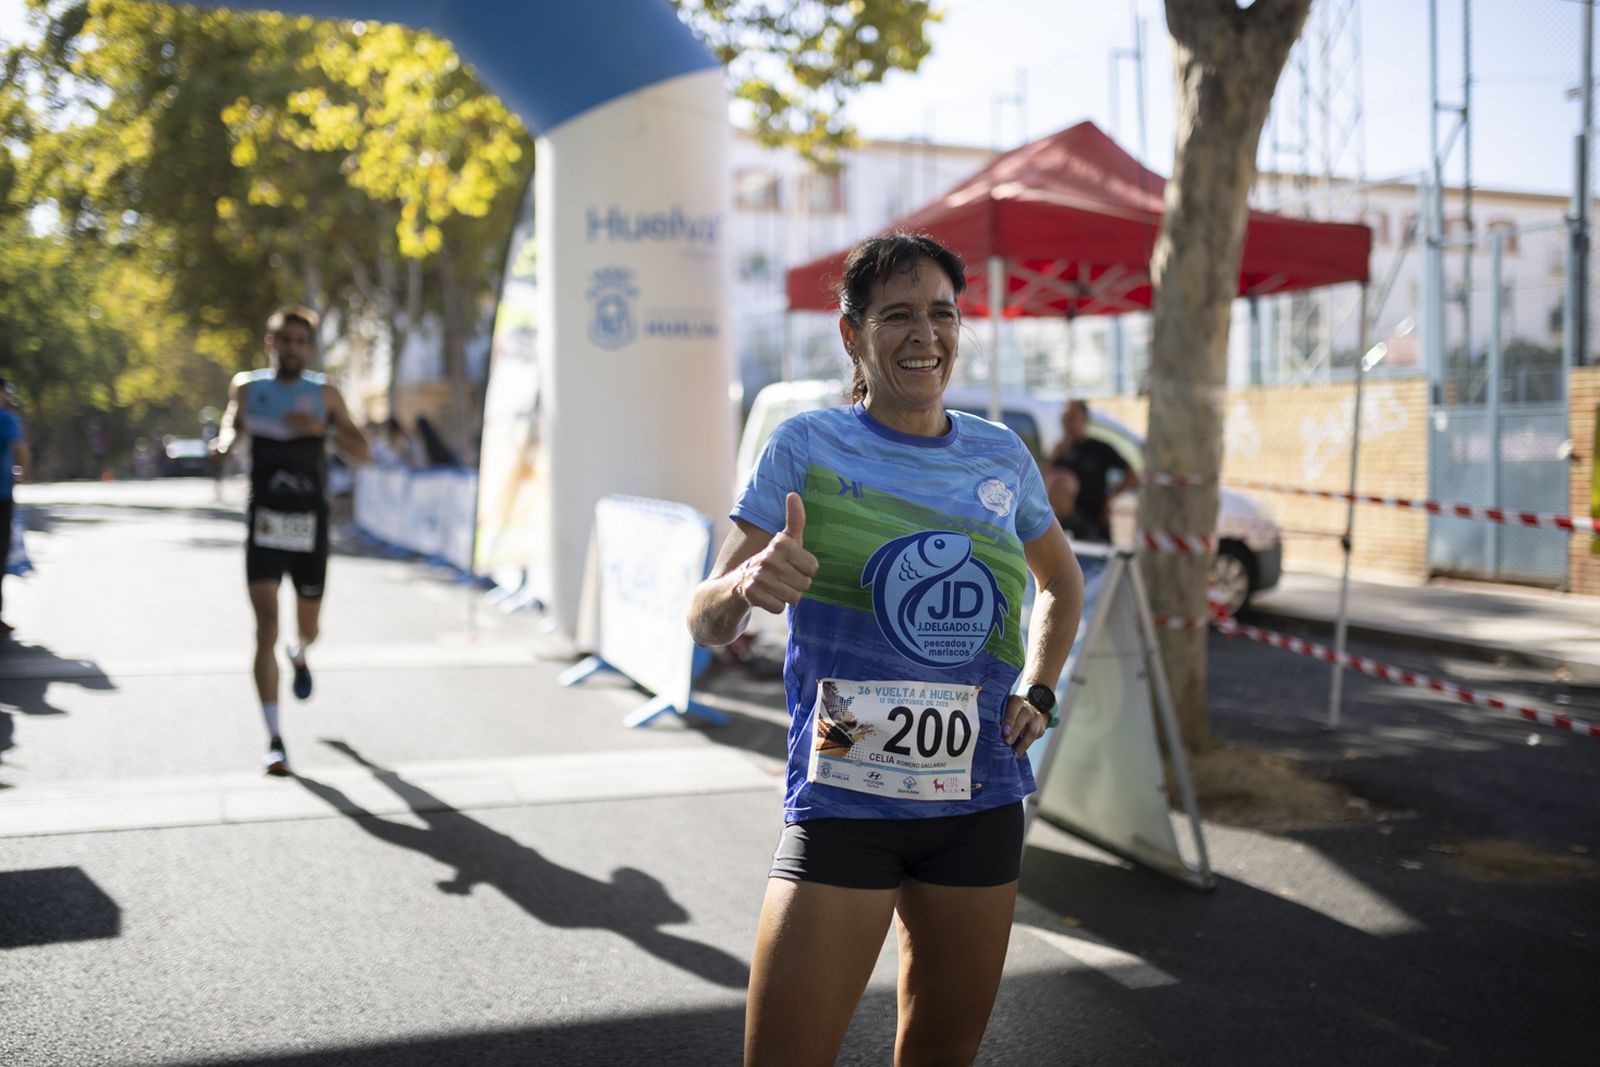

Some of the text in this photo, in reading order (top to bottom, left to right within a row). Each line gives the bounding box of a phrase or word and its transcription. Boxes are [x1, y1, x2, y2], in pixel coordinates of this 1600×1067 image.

[928, 581, 984, 620] JD
[917, 622, 987, 632] J.DELGADO S.L.
[924, 639, 975, 649] pescados y
[858, 686, 969, 702] 36 VUELTA A HUELVA
[883, 706, 972, 758] 200
[869, 753, 895, 764] CELIA
